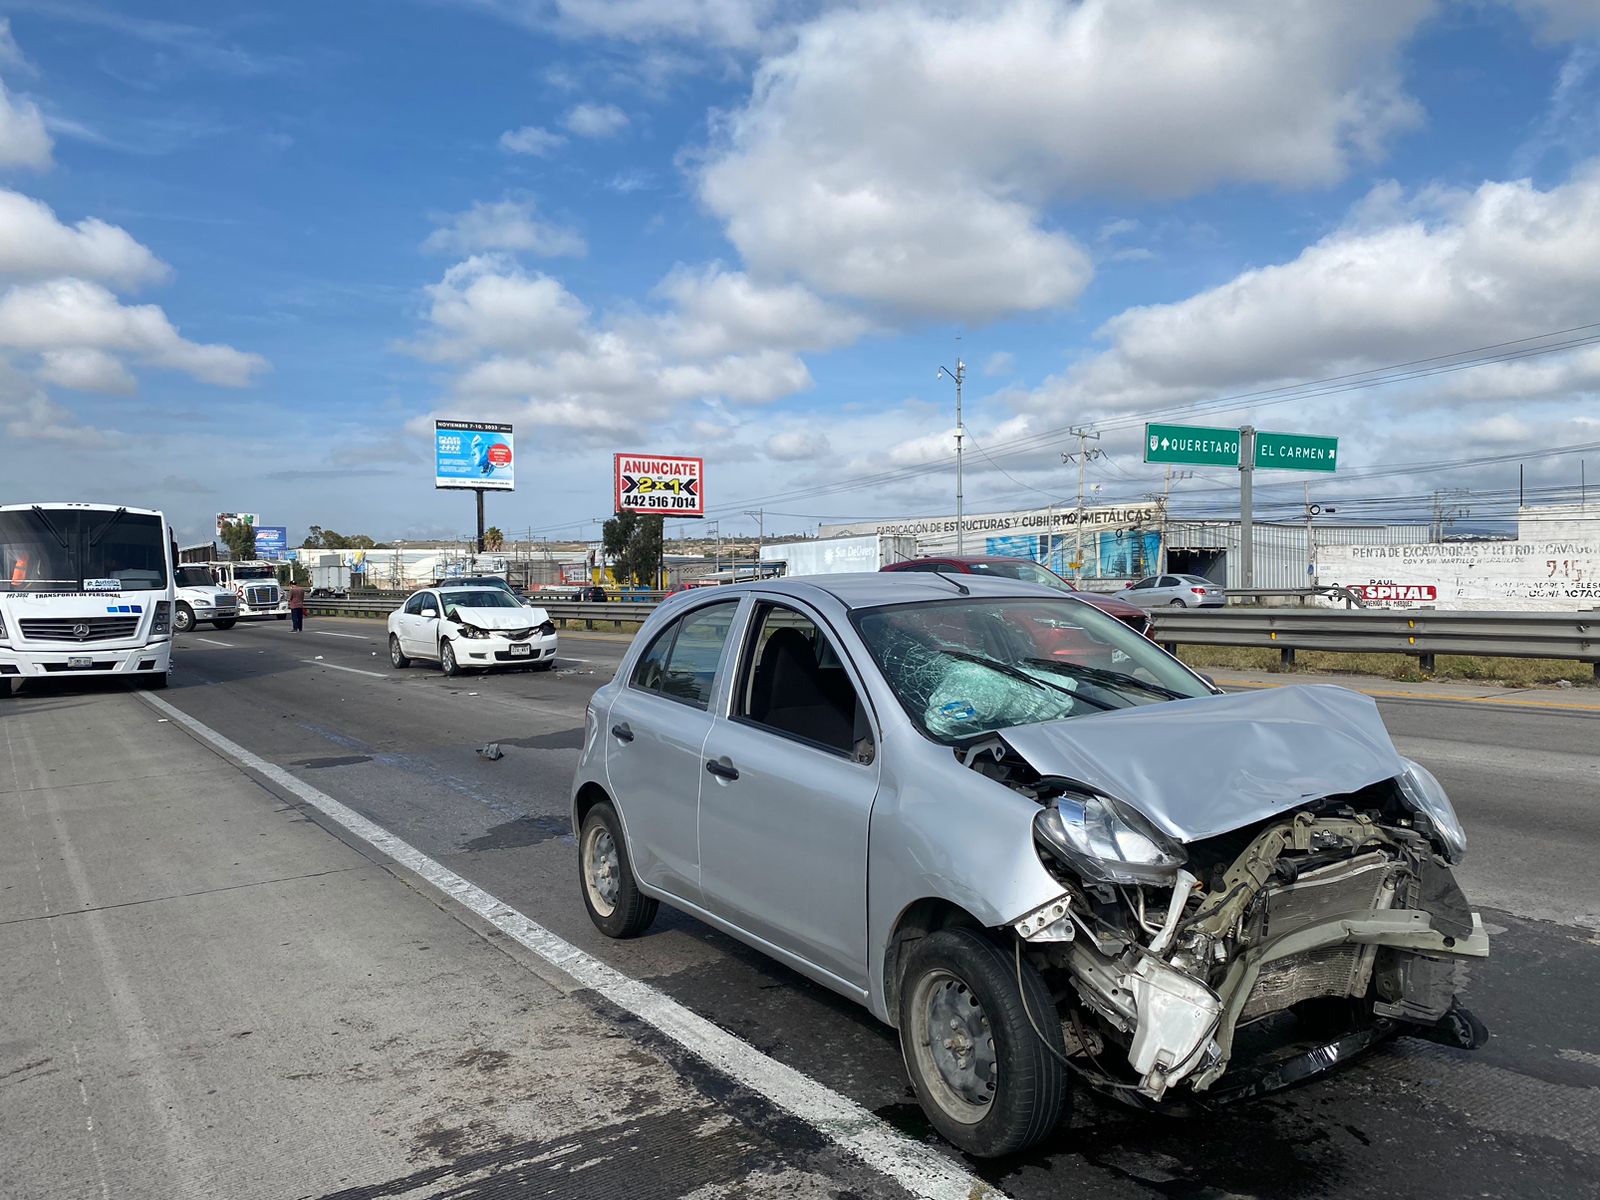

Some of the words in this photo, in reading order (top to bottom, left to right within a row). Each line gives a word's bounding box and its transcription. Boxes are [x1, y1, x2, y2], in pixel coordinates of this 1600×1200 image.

[1171, 438, 1238, 454] QUERETARO
[1261, 445, 1275, 457] EL
[1279, 445, 1324, 459] CARMEN
[623, 460, 696, 476] ANUNCIATE
[624, 495, 646, 507] 442
[648, 495, 668, 507] 516
[671, 496, 696, 508] 7014
[876, 521, 928, 535] FABRICACIÓN
[930, 522, 942, 533] DE
[944, 517, 1011, 532] ESTRUCTURAS
[1013, 516, 1019, 527] Y
[1085, 507, 1152, 524] METÁLICAS
[1352, 547, 1387, 558] RENTA
[1388, 547, 1400, 558] DE
[1403, 545, 1479, 558] EXCAVADORAS
